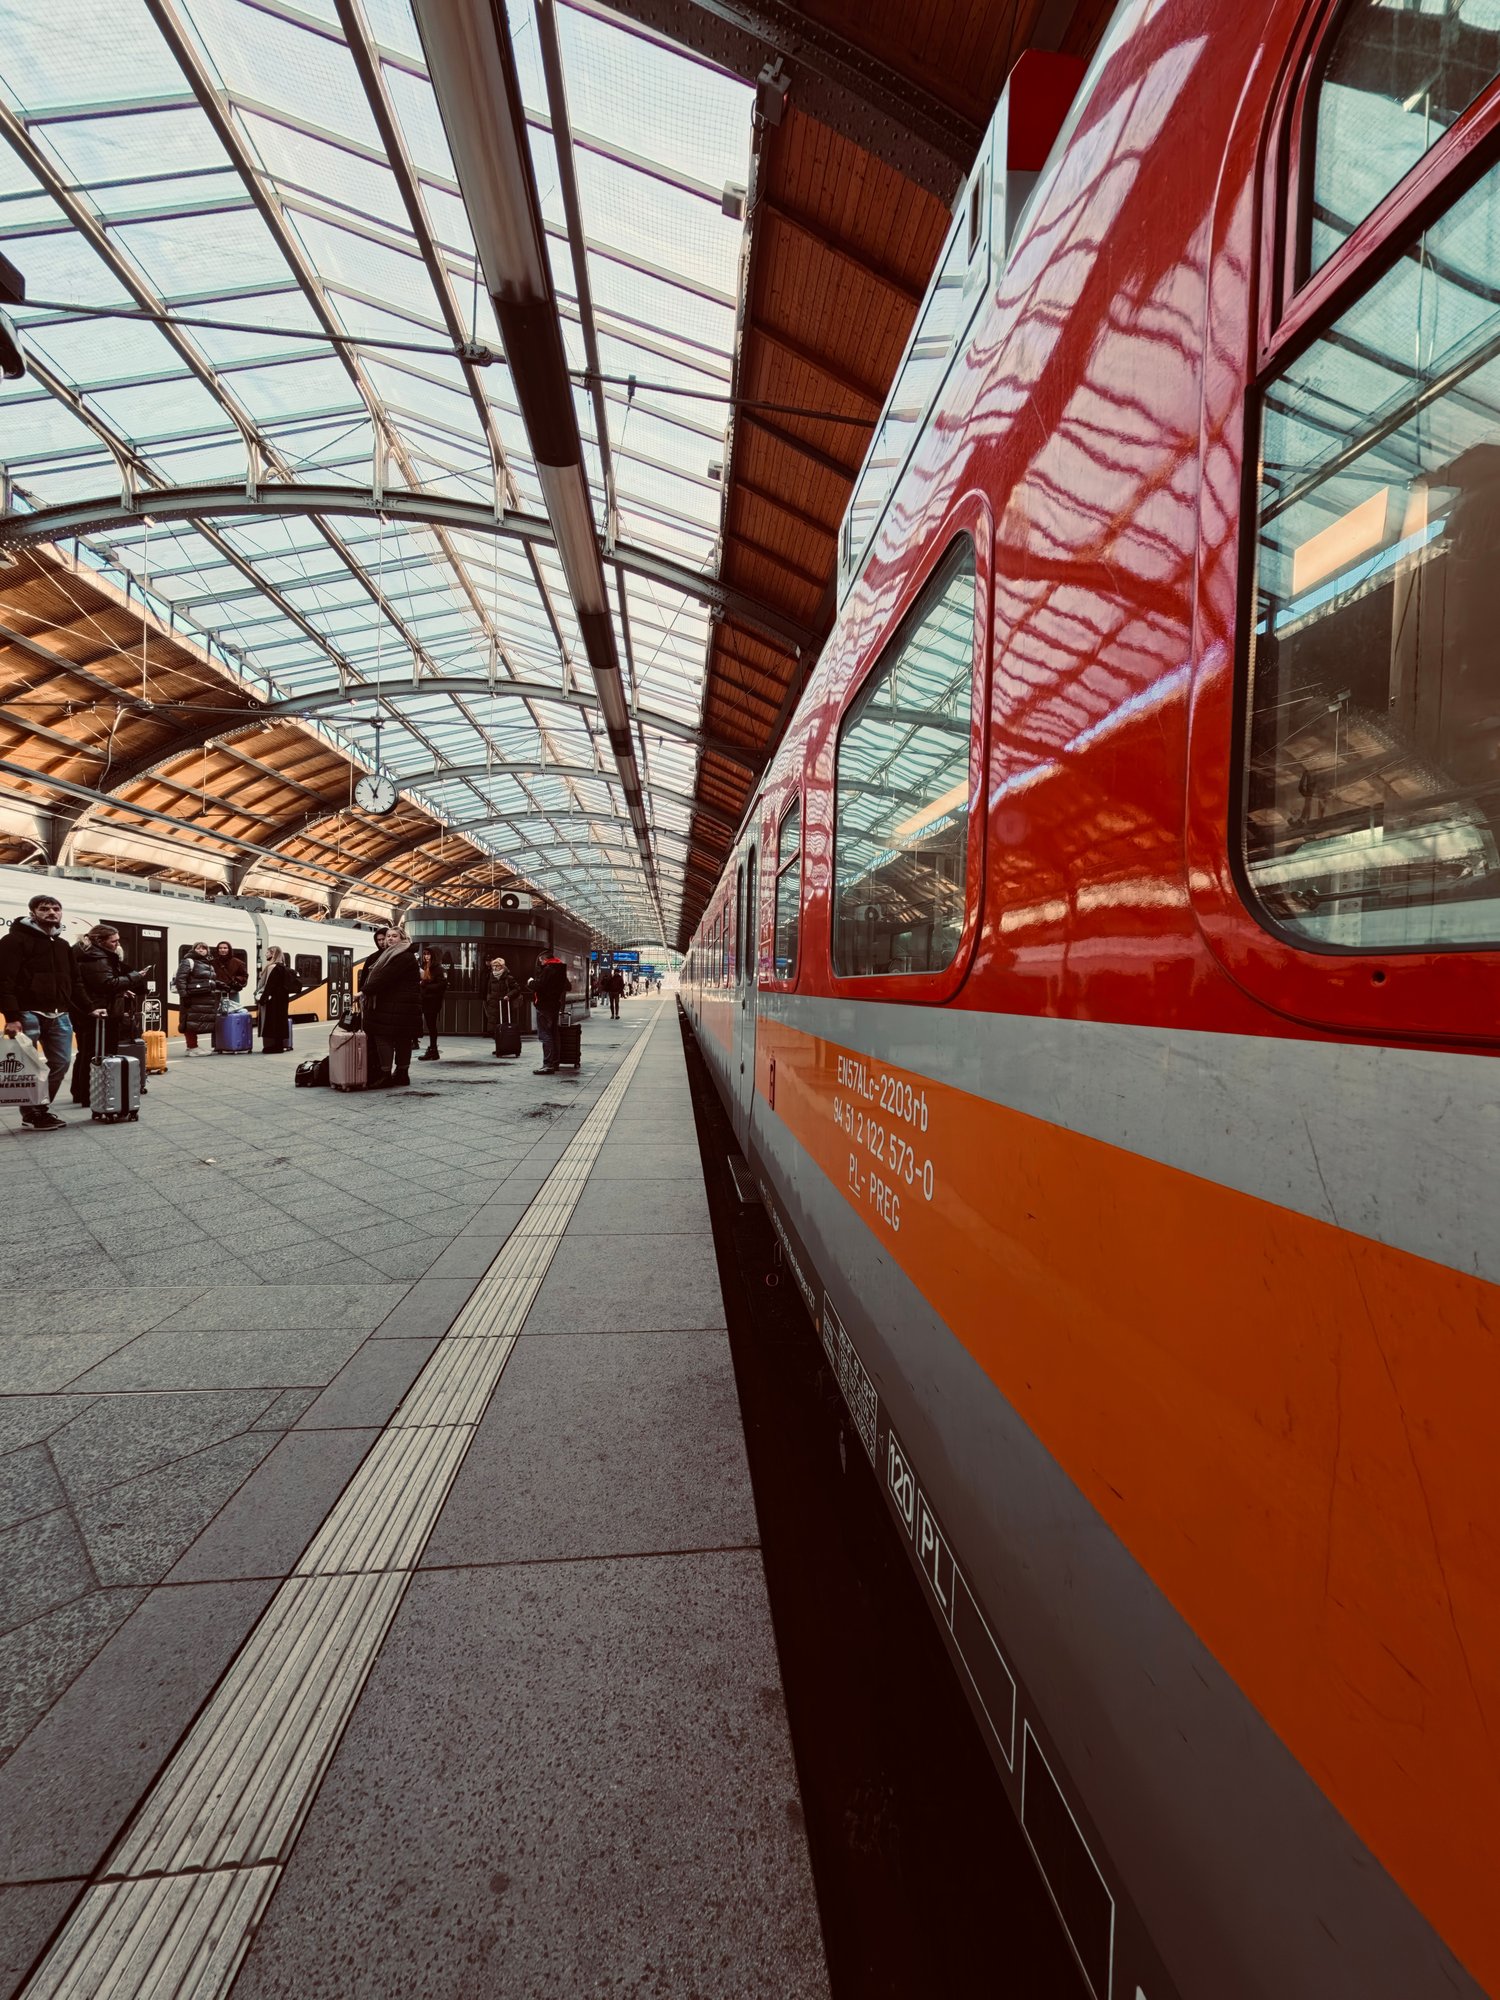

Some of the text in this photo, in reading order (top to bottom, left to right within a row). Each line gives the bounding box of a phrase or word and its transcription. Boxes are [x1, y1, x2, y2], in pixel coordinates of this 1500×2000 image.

[332, 998, 337, 1013] 2
[4, 1074, 36, 1082] HEART
[837, 1055, 928, 1132] EN57ALc-2203rb
[833, 1096, 934, 1201] 94 51 2 122 573-0
[869, 1172, 900, 1232] PREG
[889, 1443, 913, 1523] 120
[921, 1509, 947, 1607] PL
